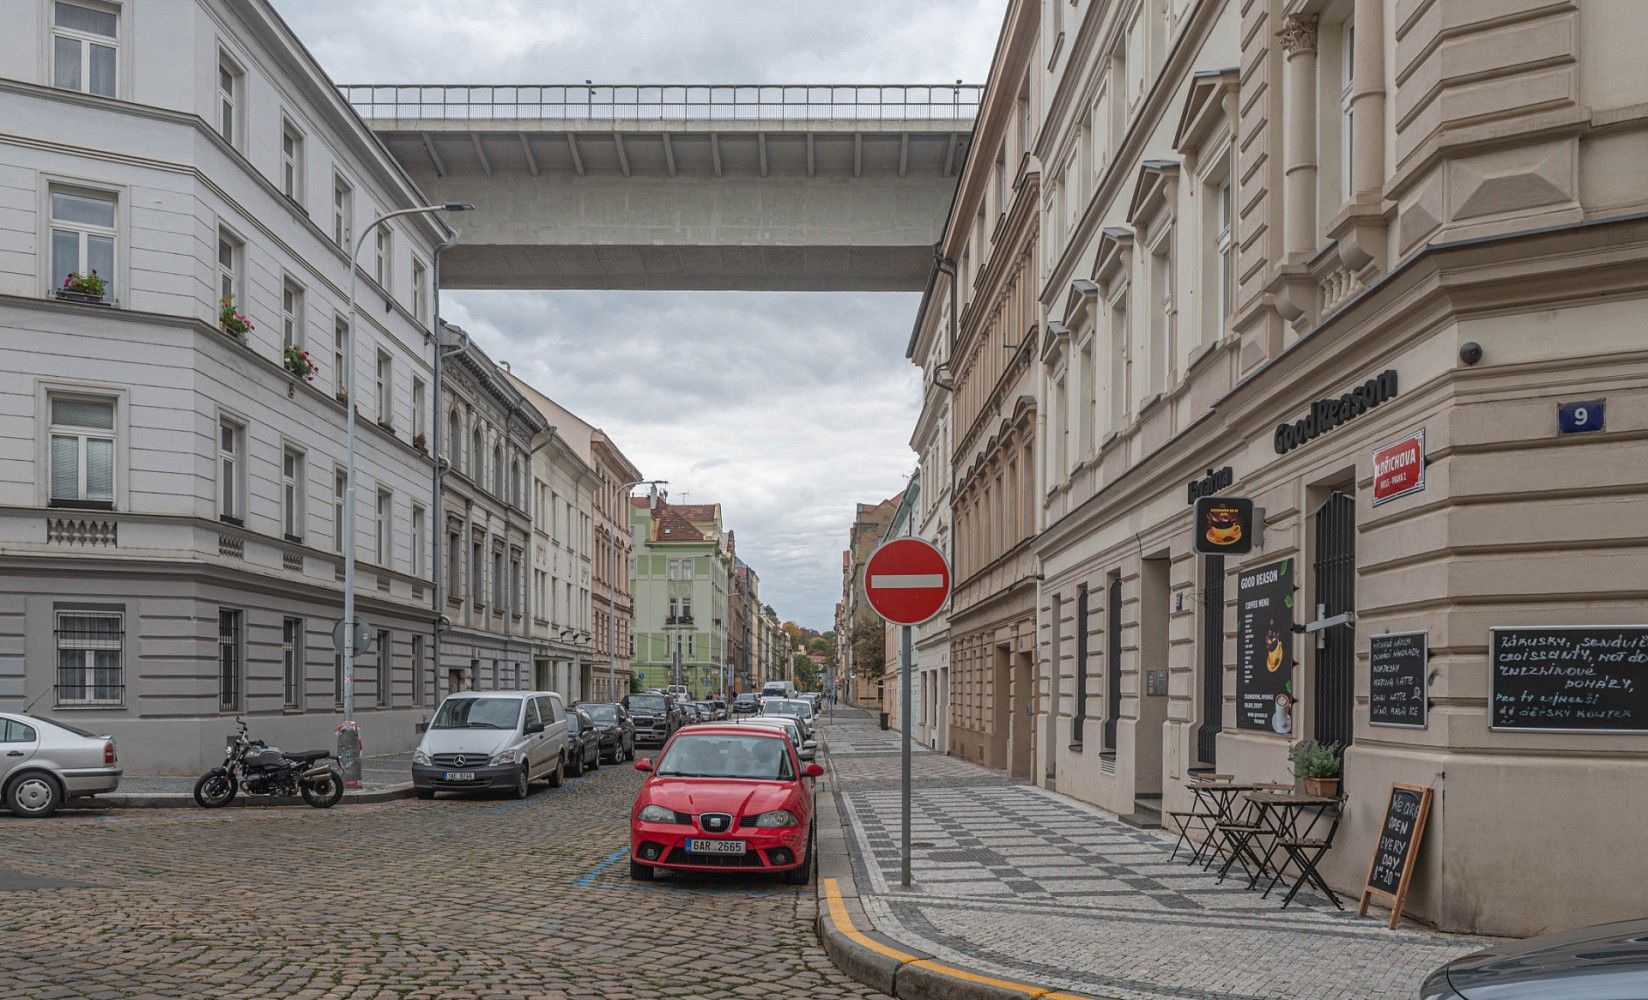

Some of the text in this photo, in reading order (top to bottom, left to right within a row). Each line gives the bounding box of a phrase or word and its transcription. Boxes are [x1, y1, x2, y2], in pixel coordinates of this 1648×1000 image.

[1574, 407, 1588, 426] 9
[1240, 569, 1278, 590] GOOD REASON
[1388, 816, 1409, 835] OPEN
[693, 840, 742, 852] 6AR 2665
[1380, 836, 1407, 855] EVERY
[1381, 853, 1400, 870] DAY
